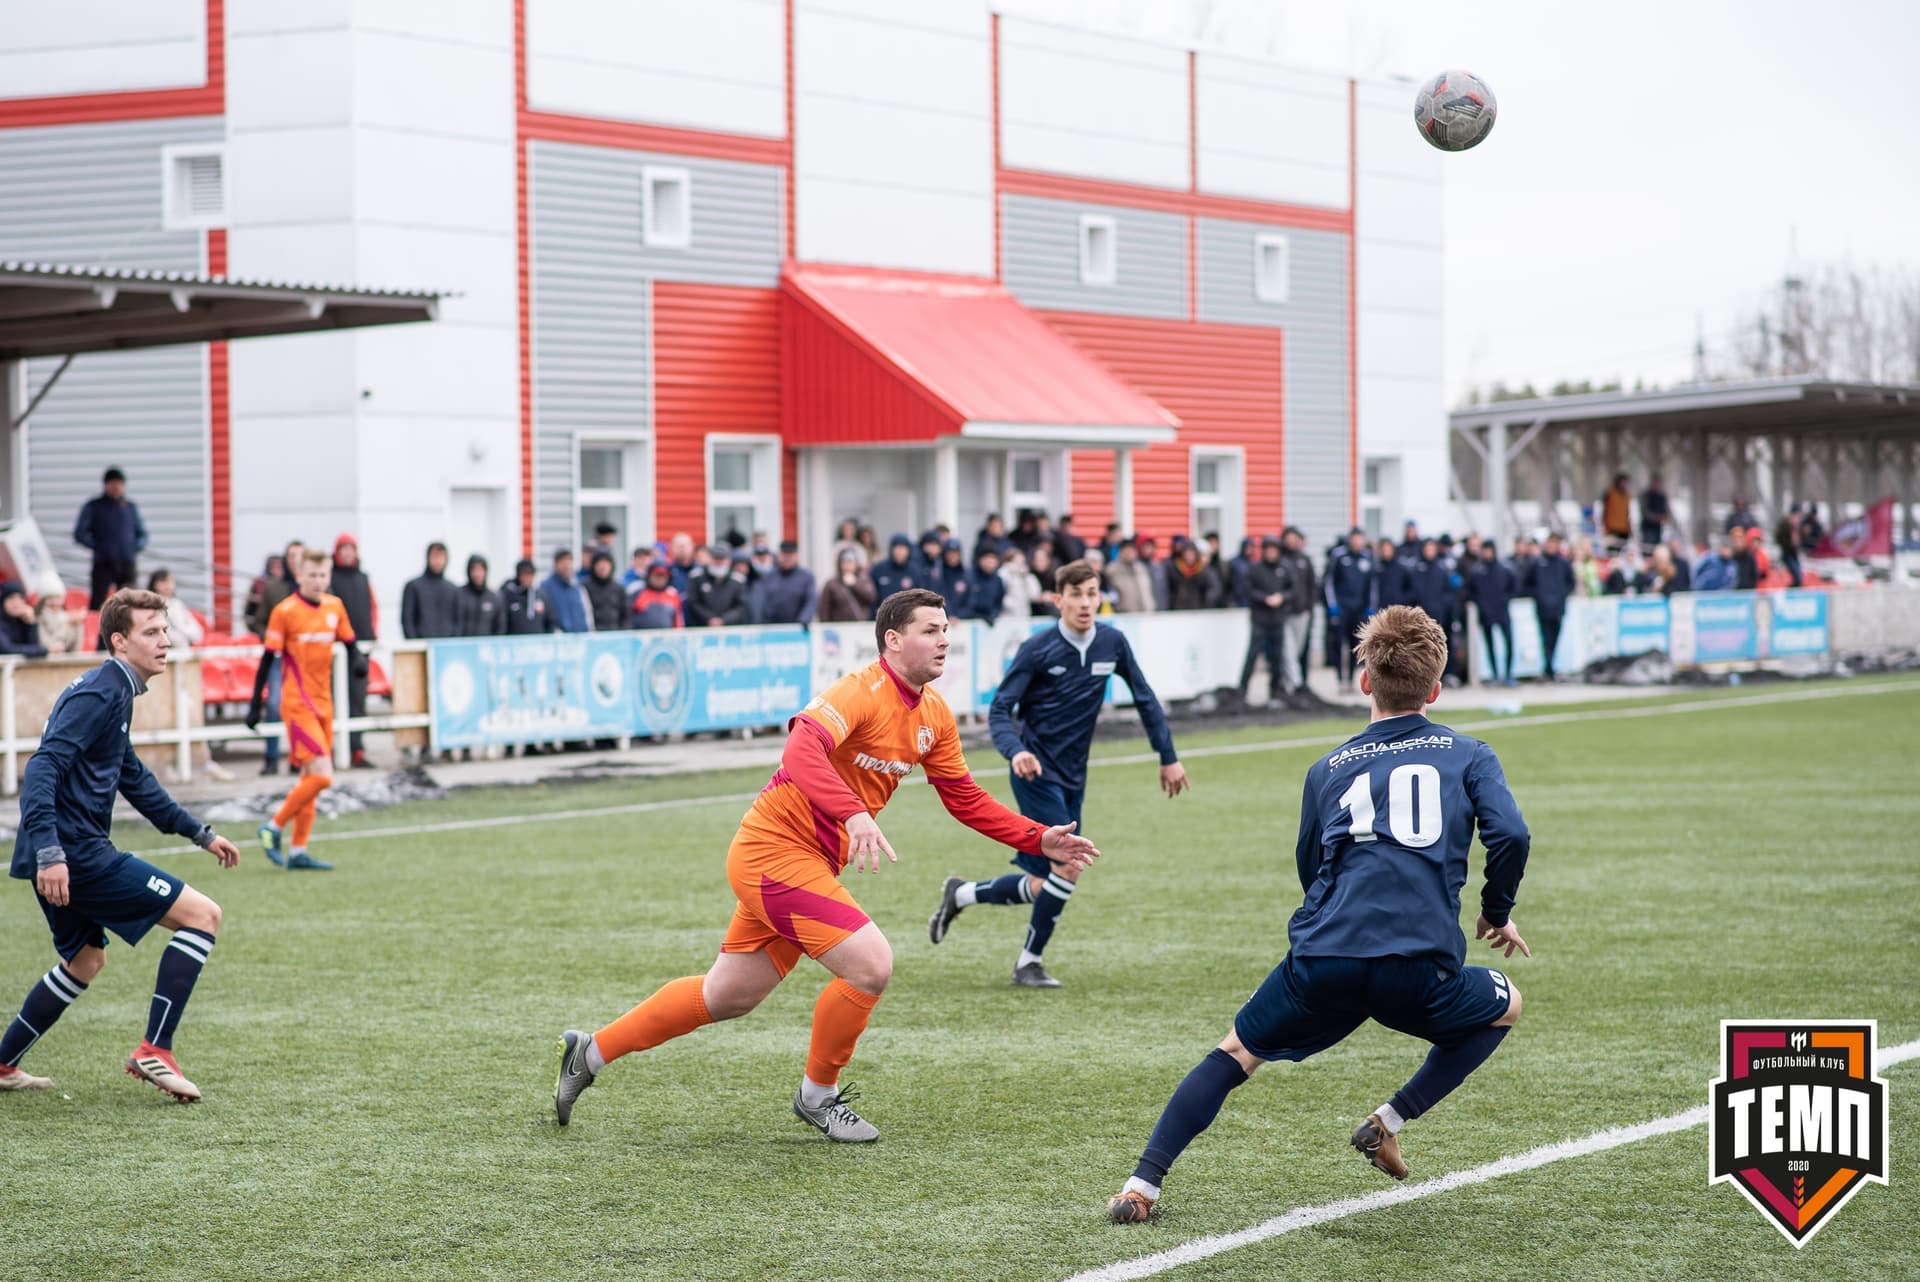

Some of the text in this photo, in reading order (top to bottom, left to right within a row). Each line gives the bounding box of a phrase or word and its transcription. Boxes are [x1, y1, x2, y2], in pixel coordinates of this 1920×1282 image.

[1339, 763, 1443, 848] 10
[146, 874, 172, 897] 5
[1488, 969, 1508, 1000] 10
